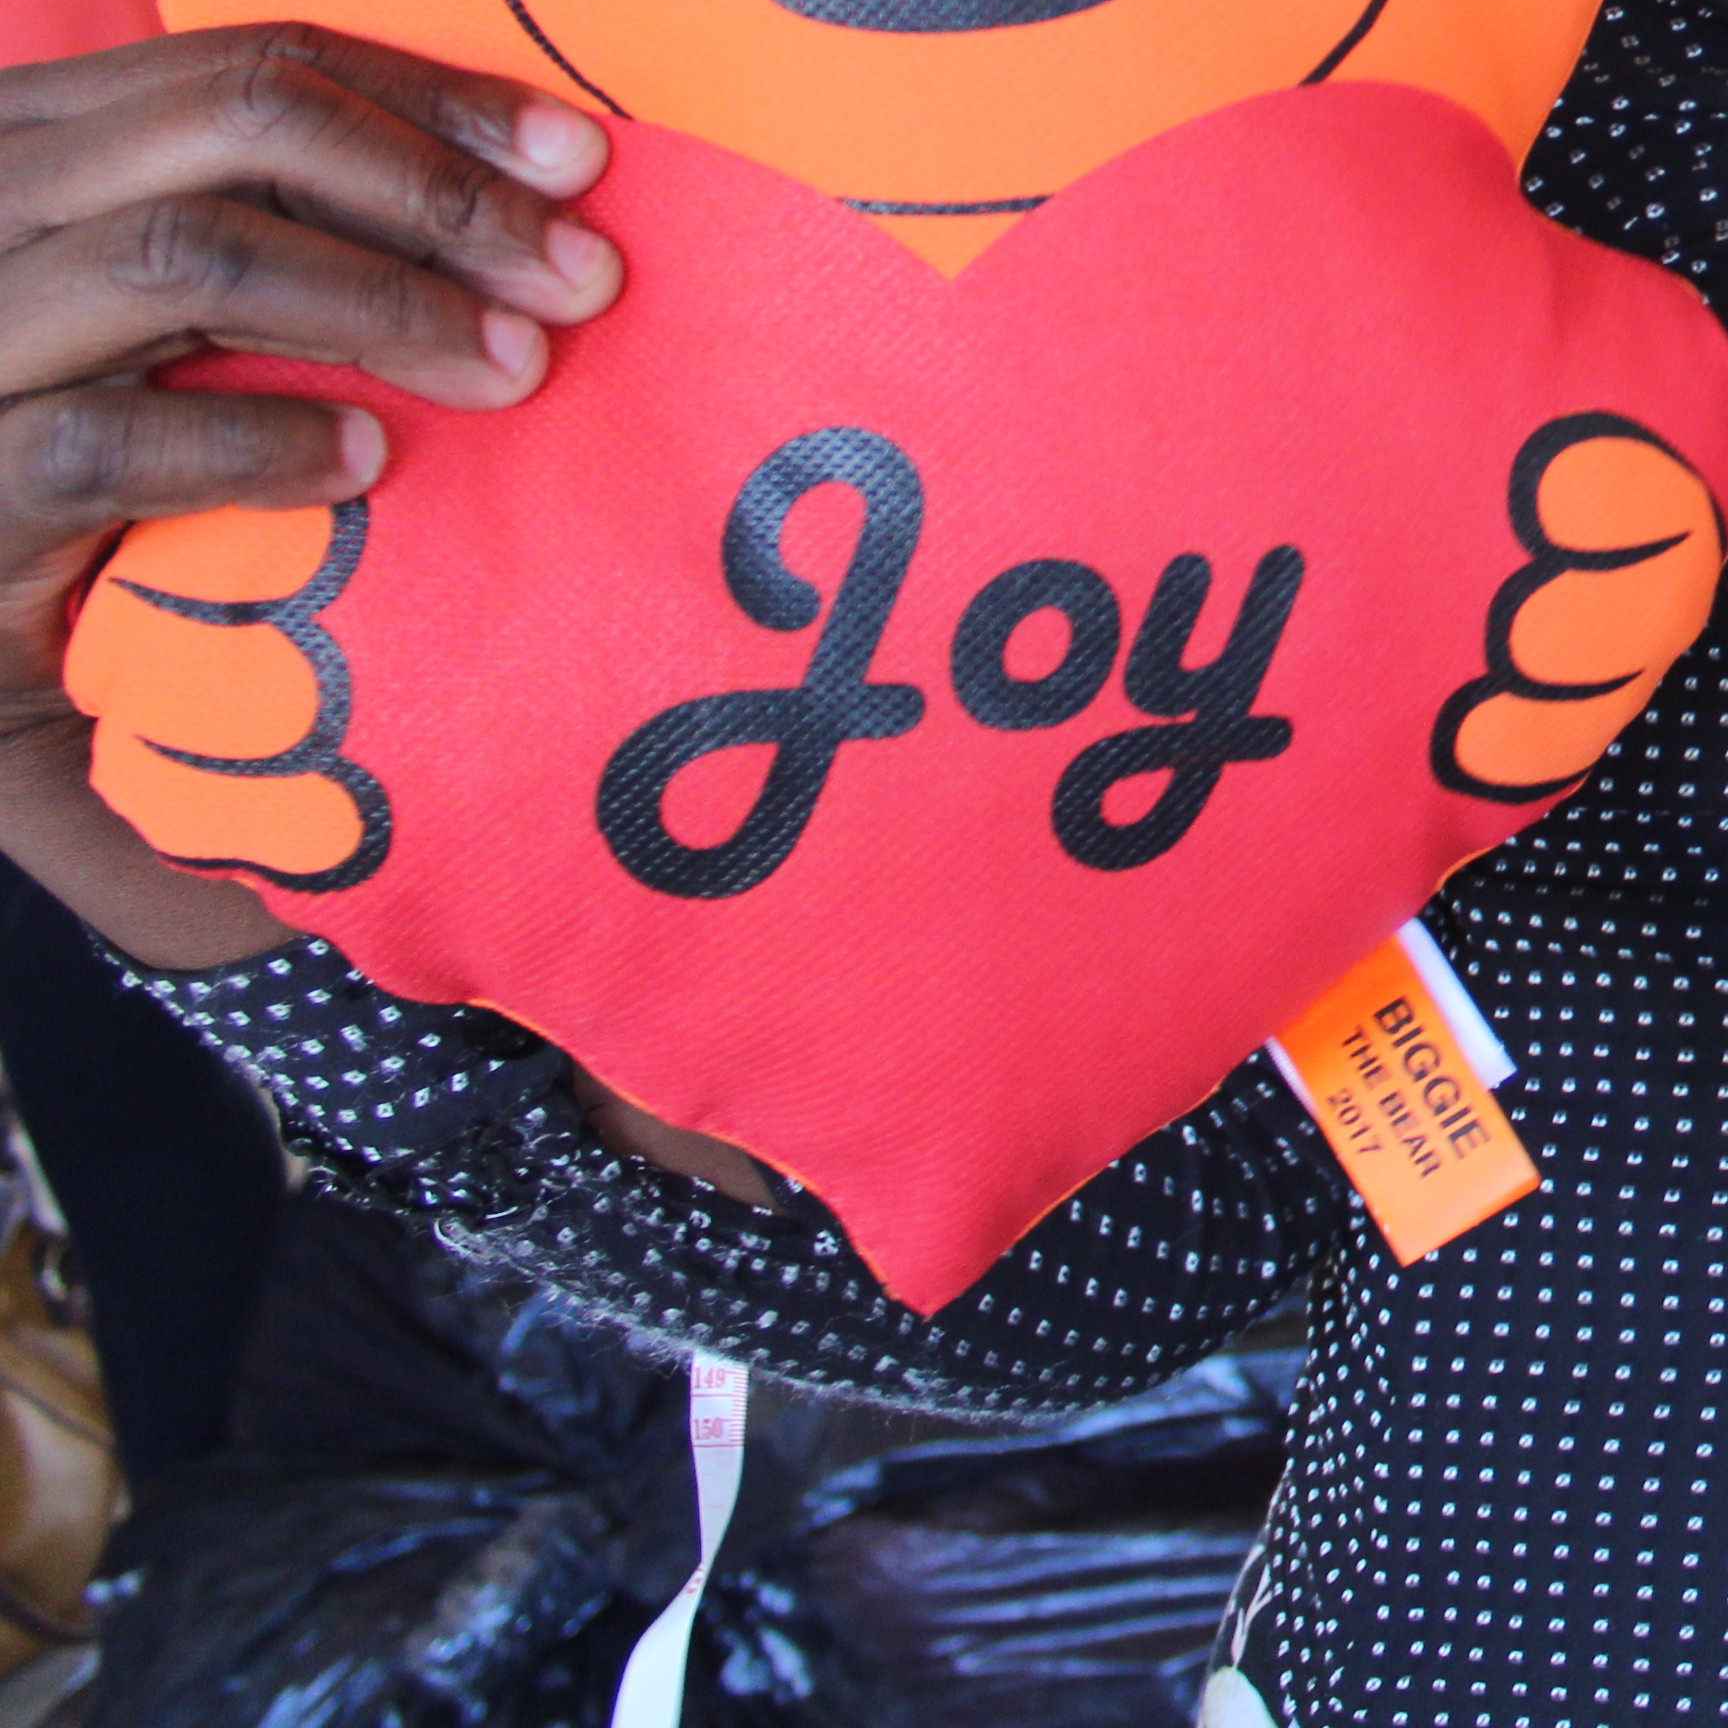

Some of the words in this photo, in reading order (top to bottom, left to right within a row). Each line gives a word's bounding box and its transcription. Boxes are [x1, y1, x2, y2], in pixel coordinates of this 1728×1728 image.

[595, 426, 1306, 900] Joy
[1328, 1087, 1384, 1155] 2017
[1342, 1023, 1392, 1090] THE
[1379, 1090, 1443, 1180] BEAR
[1374, 996, 1491, 1161] BIGGIE
[692, 1366, 727, 1390] 149
[693, 1417, 723, 1440] 150
